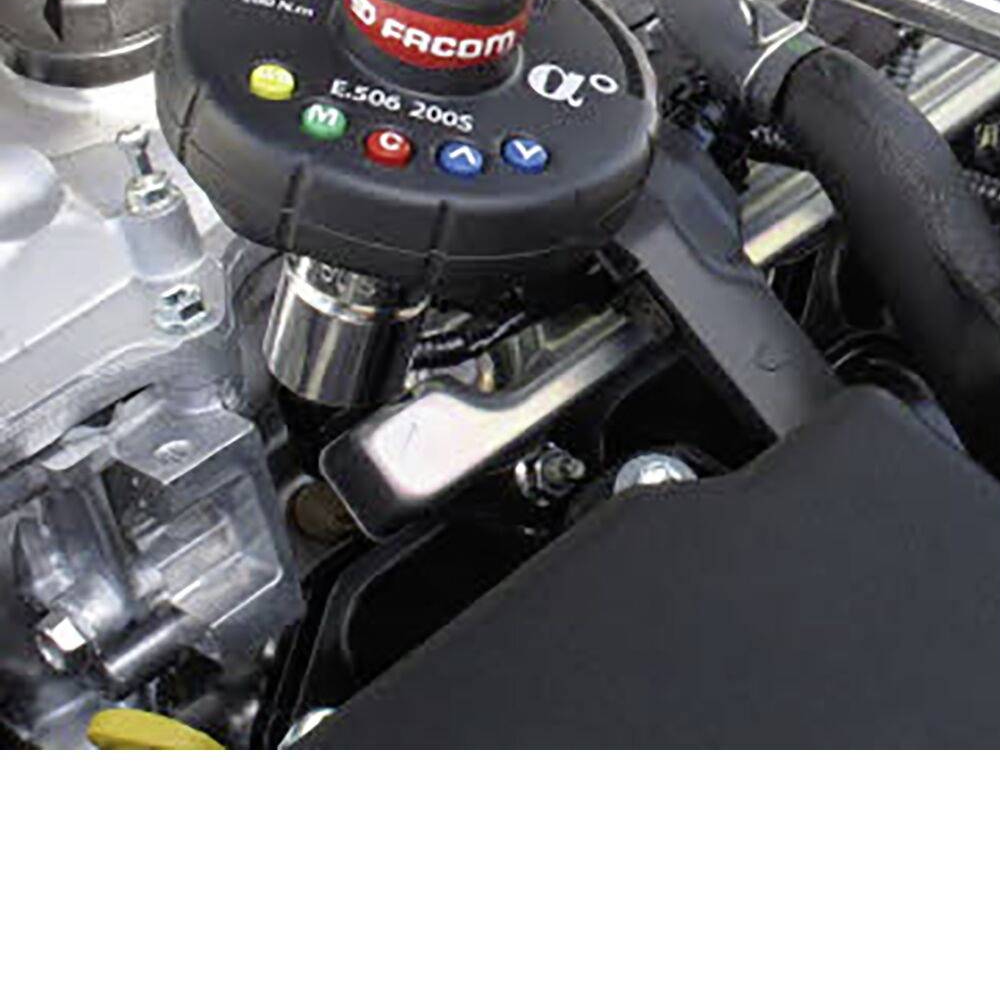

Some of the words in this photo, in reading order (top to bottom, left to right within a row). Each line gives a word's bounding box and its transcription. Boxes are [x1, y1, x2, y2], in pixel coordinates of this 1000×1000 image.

[380, 17, 516, 59] FACOM
[306, 103, 340, 127] M
[330, 78, 401, 111] E.506
[409, 100, 474, 133] 200S
[379, 131, 404, 150] C
